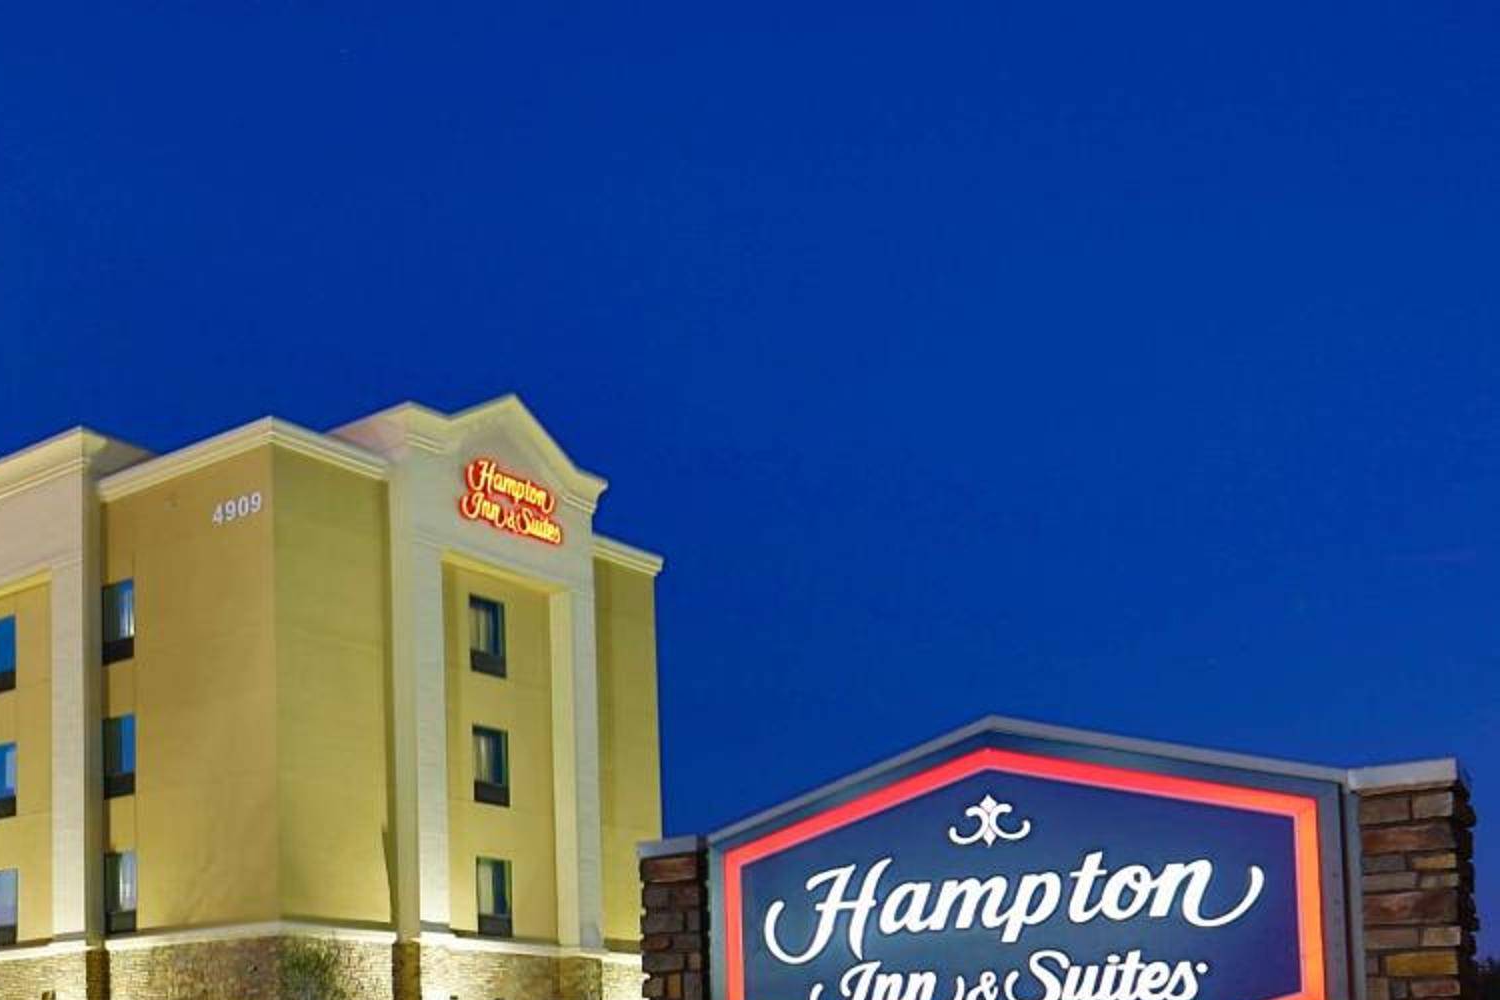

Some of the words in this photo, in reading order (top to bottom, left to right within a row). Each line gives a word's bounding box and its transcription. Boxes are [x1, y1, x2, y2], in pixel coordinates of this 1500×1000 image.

[212, 491, 261, 525] 4909
[467, 459, 556, 514] Hampton
[461, 491, 508, 527] Inn
[516, 506, 561, 544] Suites
[763, 850, 1265, 965] Hampton
